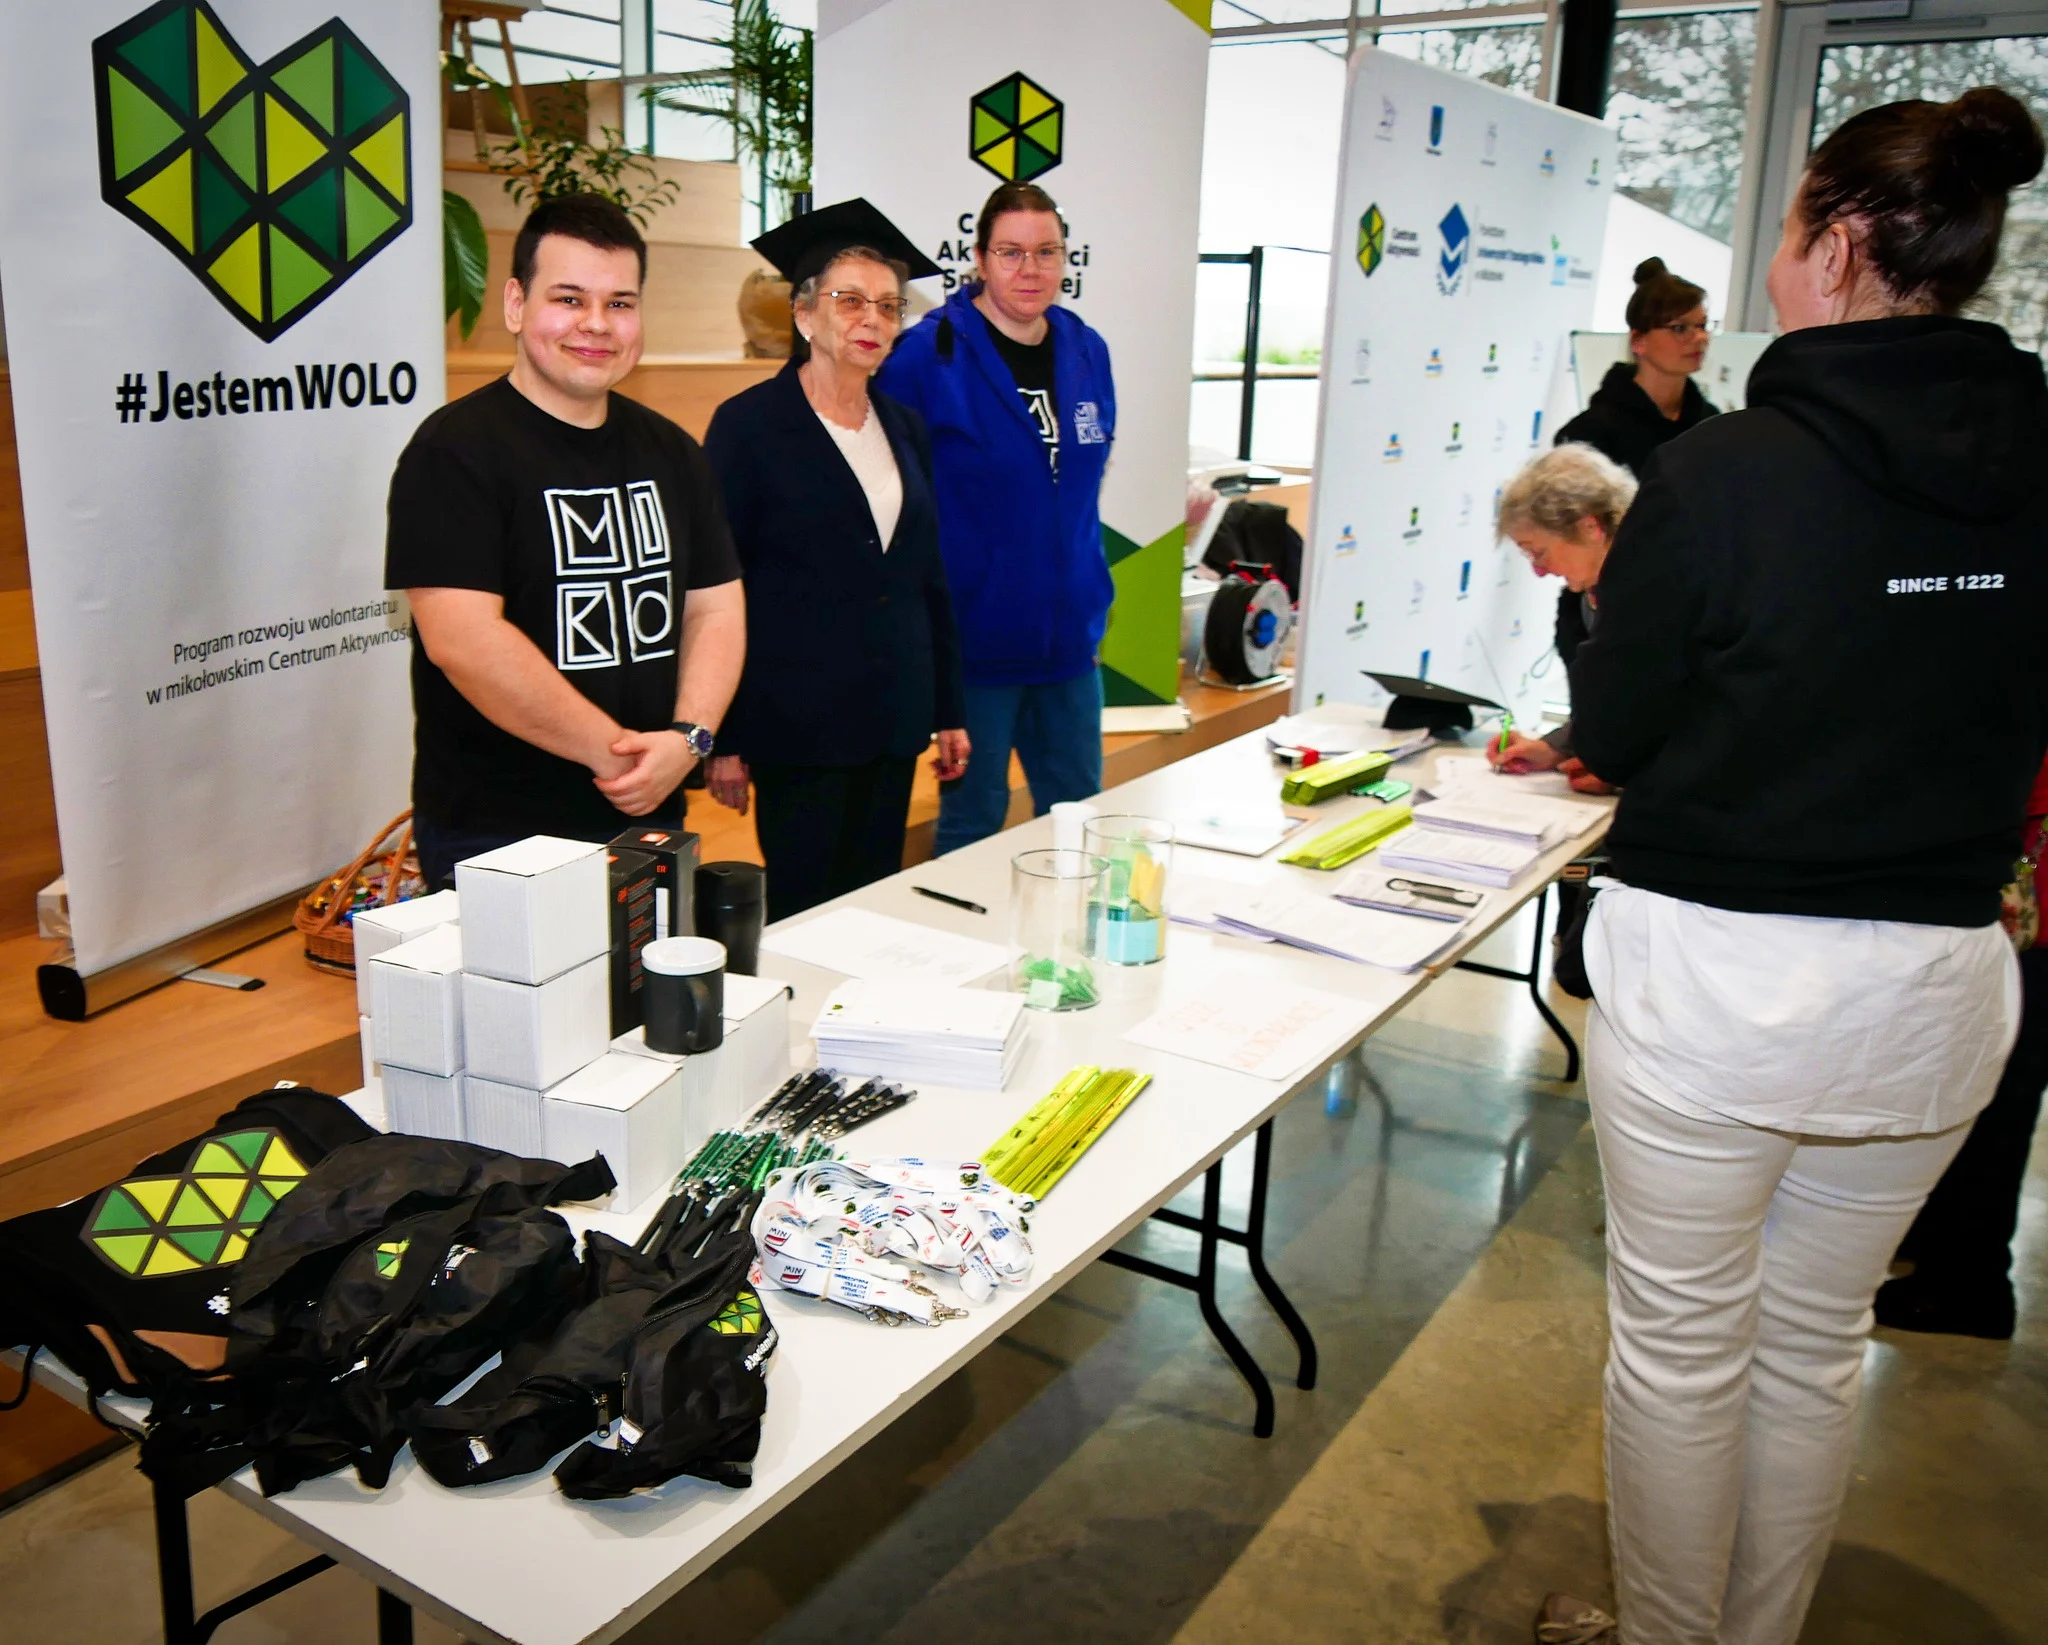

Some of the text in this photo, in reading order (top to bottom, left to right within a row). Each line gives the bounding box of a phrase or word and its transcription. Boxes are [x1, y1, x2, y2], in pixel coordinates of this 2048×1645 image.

[116, 361, 417, 423] #JestemWOLO
[1886, 574, 2005, 594] SINCE 1222
[173, 599, 398, 665] Program rozwoju wolontariatu
[146, 688, 162, 706] w
[166, 658, 264, 700] mikołowskim
[269, 642, 336, 671] Centrum
